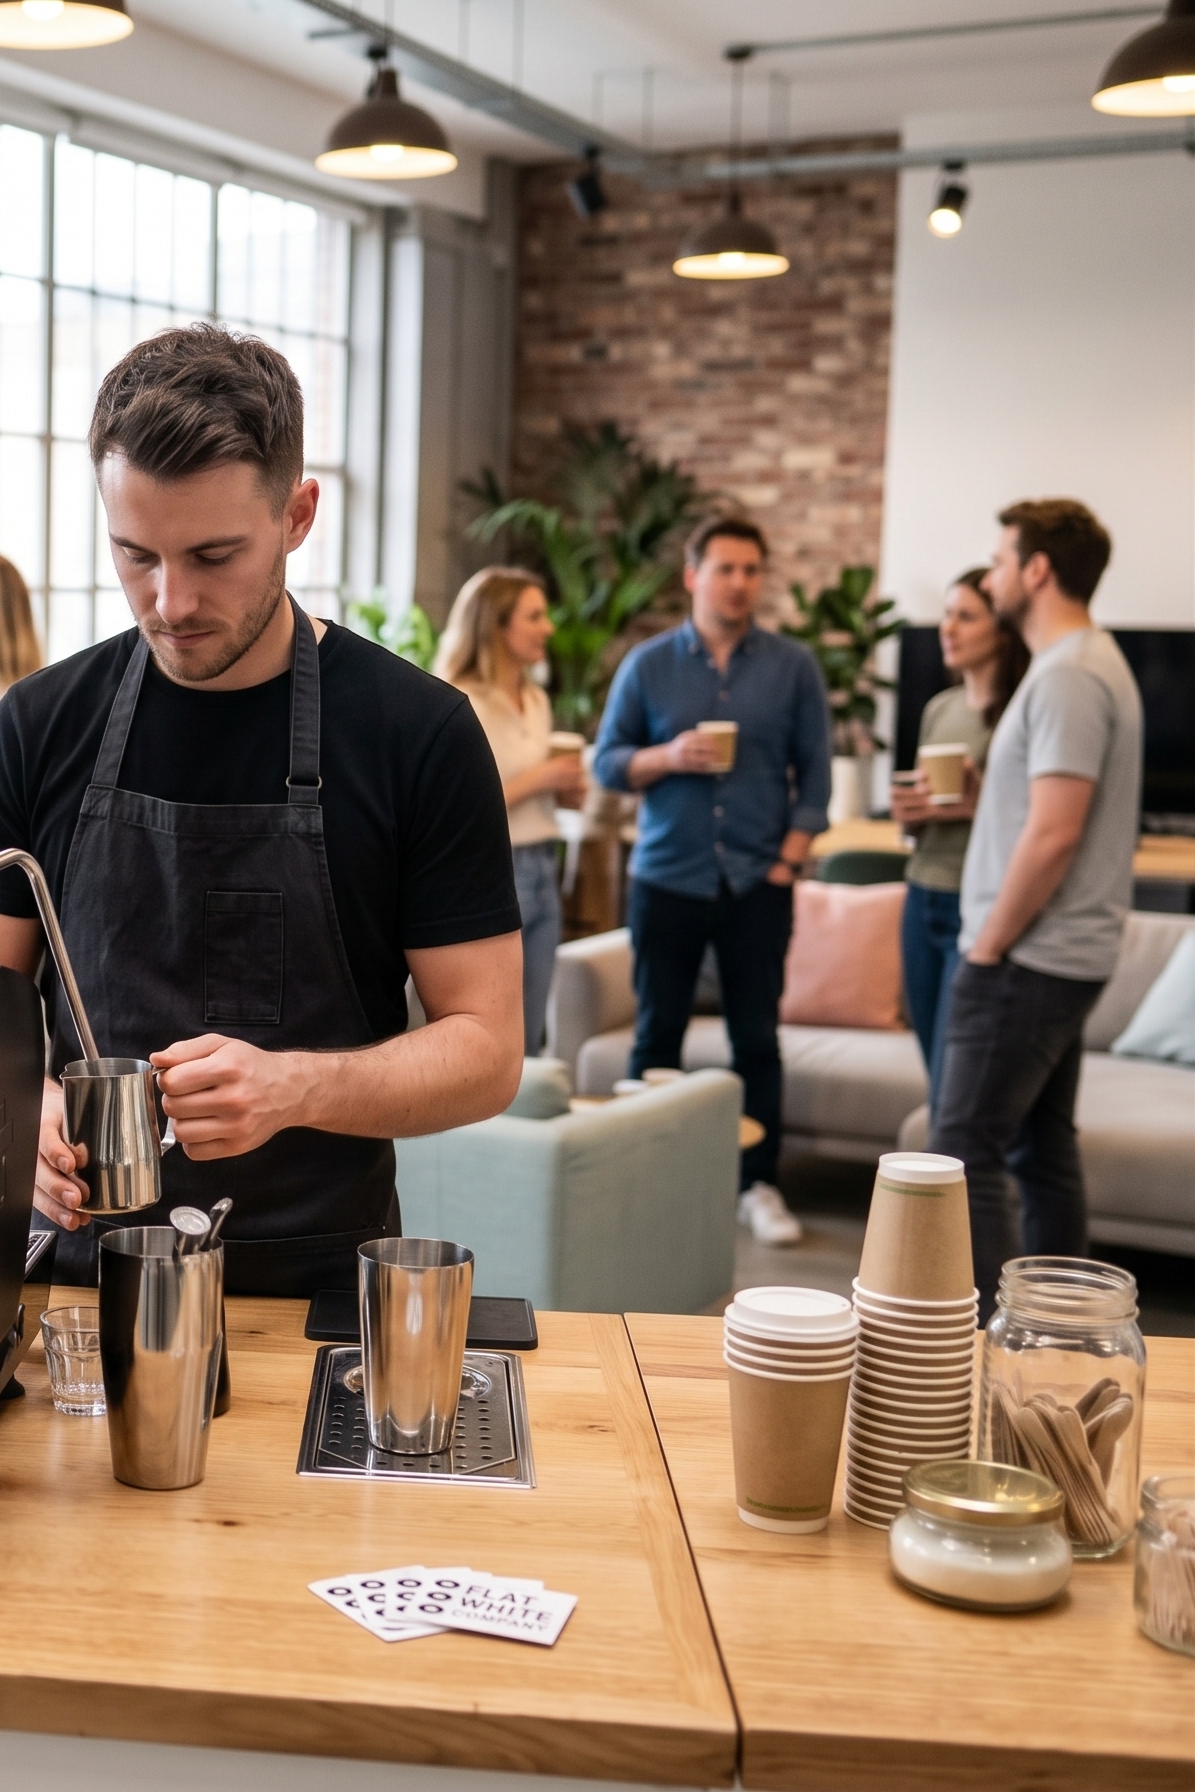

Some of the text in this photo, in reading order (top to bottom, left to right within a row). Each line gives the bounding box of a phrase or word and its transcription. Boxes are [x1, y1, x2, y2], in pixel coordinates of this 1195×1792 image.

[466, 1585, 538, 1605] FLAT
[452, 1609, 548, 1631] COMPANY
[462, 1597, 553, 1623] WHITE
